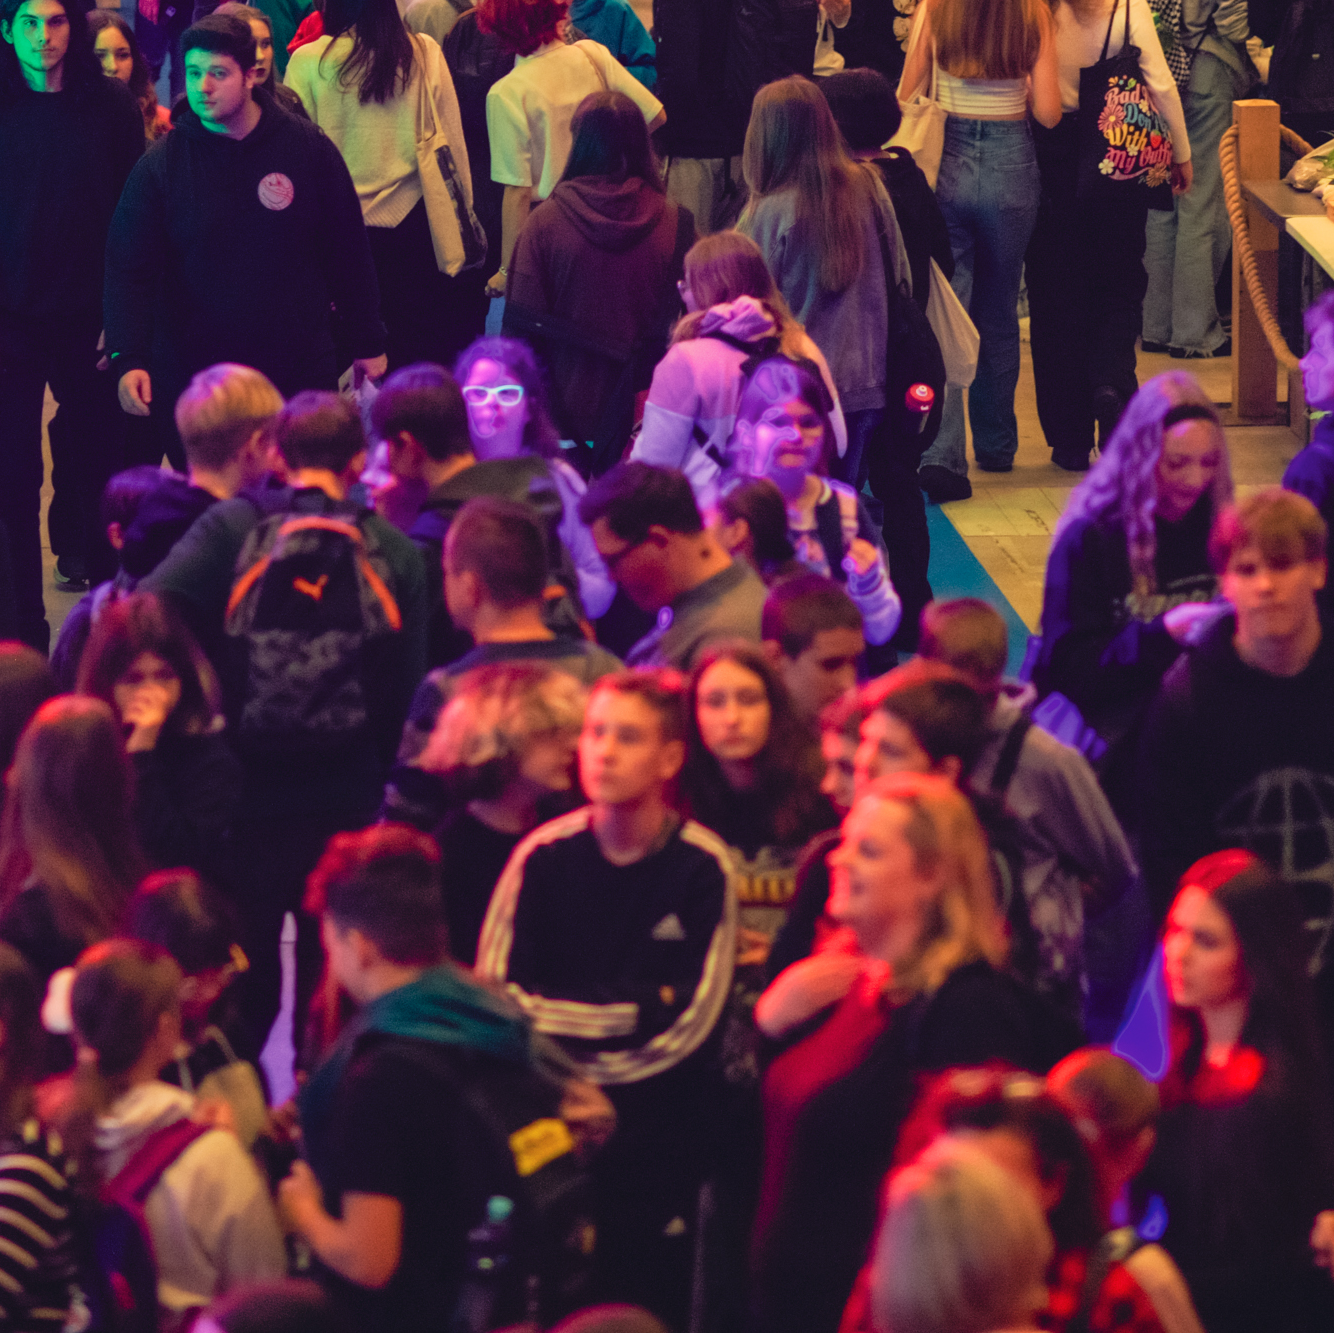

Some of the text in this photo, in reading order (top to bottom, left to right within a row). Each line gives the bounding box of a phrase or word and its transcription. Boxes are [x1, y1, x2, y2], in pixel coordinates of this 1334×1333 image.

[1104, 83, 1141, 106] Bad
[1104, 123, 1148, 152] With
[1105, 147, 1137, 174] My
